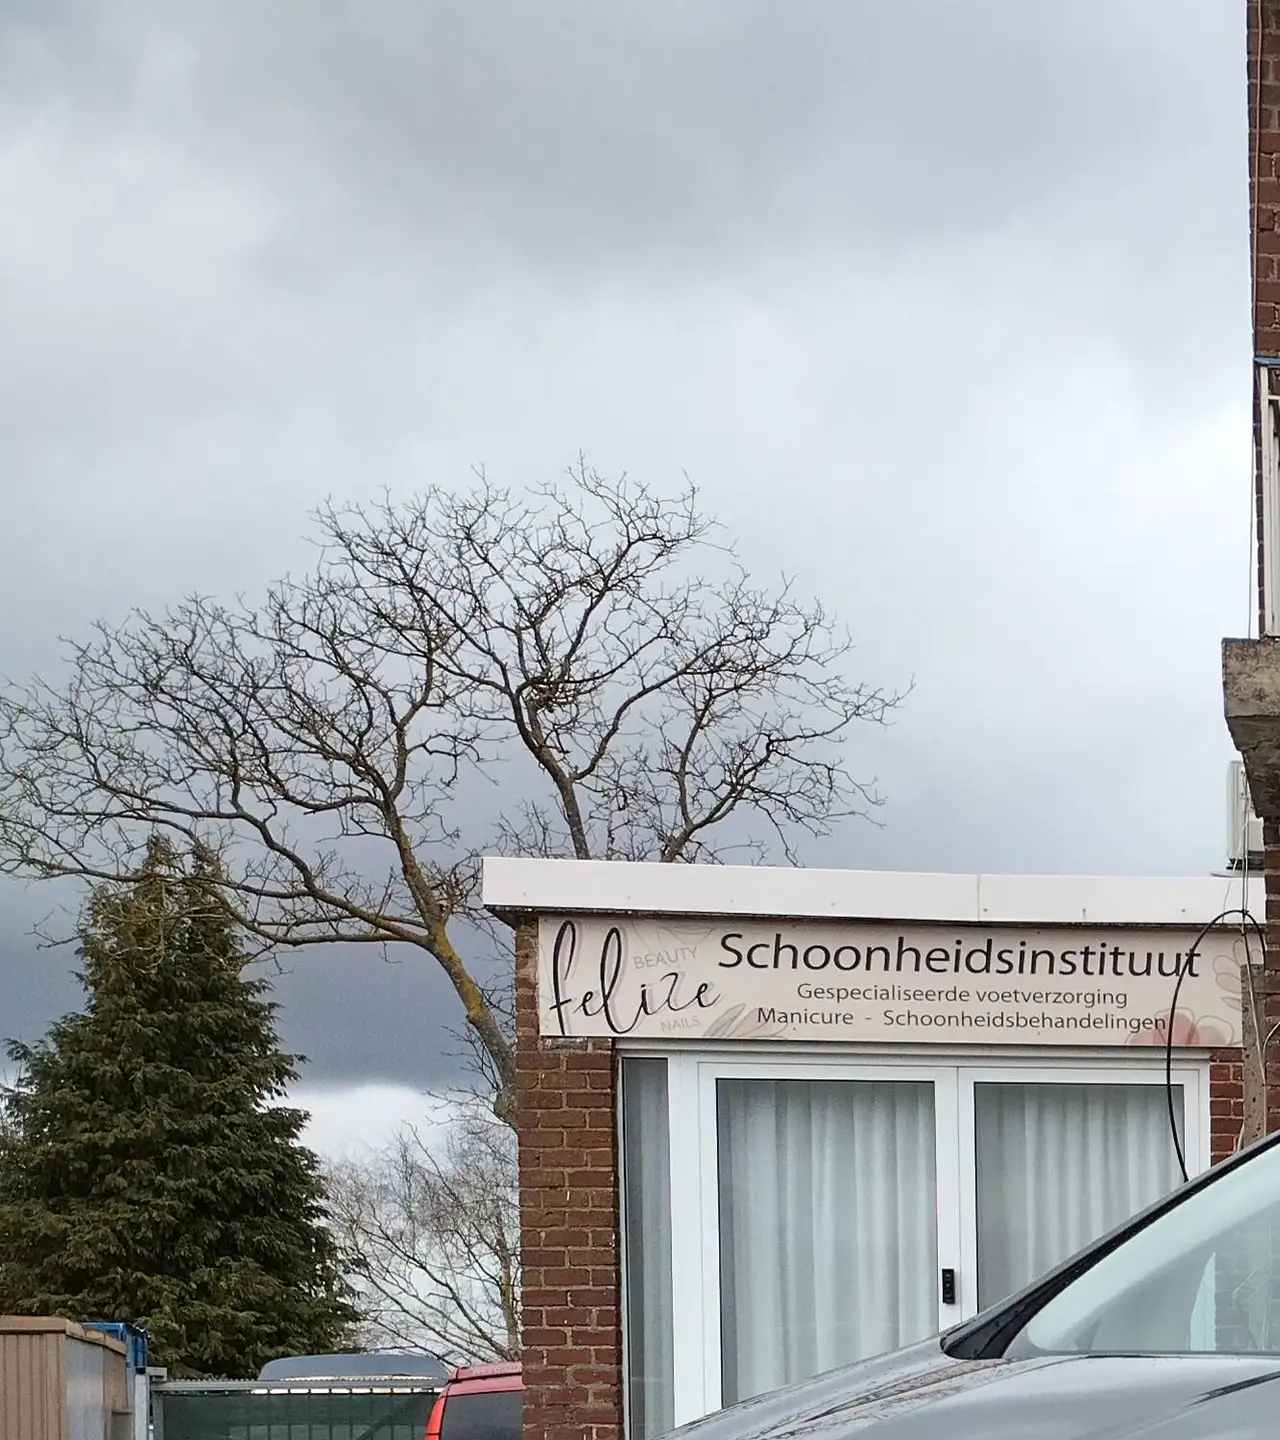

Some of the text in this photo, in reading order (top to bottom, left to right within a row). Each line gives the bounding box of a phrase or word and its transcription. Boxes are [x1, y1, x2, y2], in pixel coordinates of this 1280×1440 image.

[633, 946, 698, 970] BEAUTY
[718, 932, 1202, 977] Schoonheidsinstituut
[797, 983, 1128, 1009] Gespecialiseerde voetverzorging
[660, 1014, 701, 1032] NAILS
[757, 1007, 854, 1025] Manicure
[883, 1009, 1166, 1034] Schoonheidsbehandelingen
